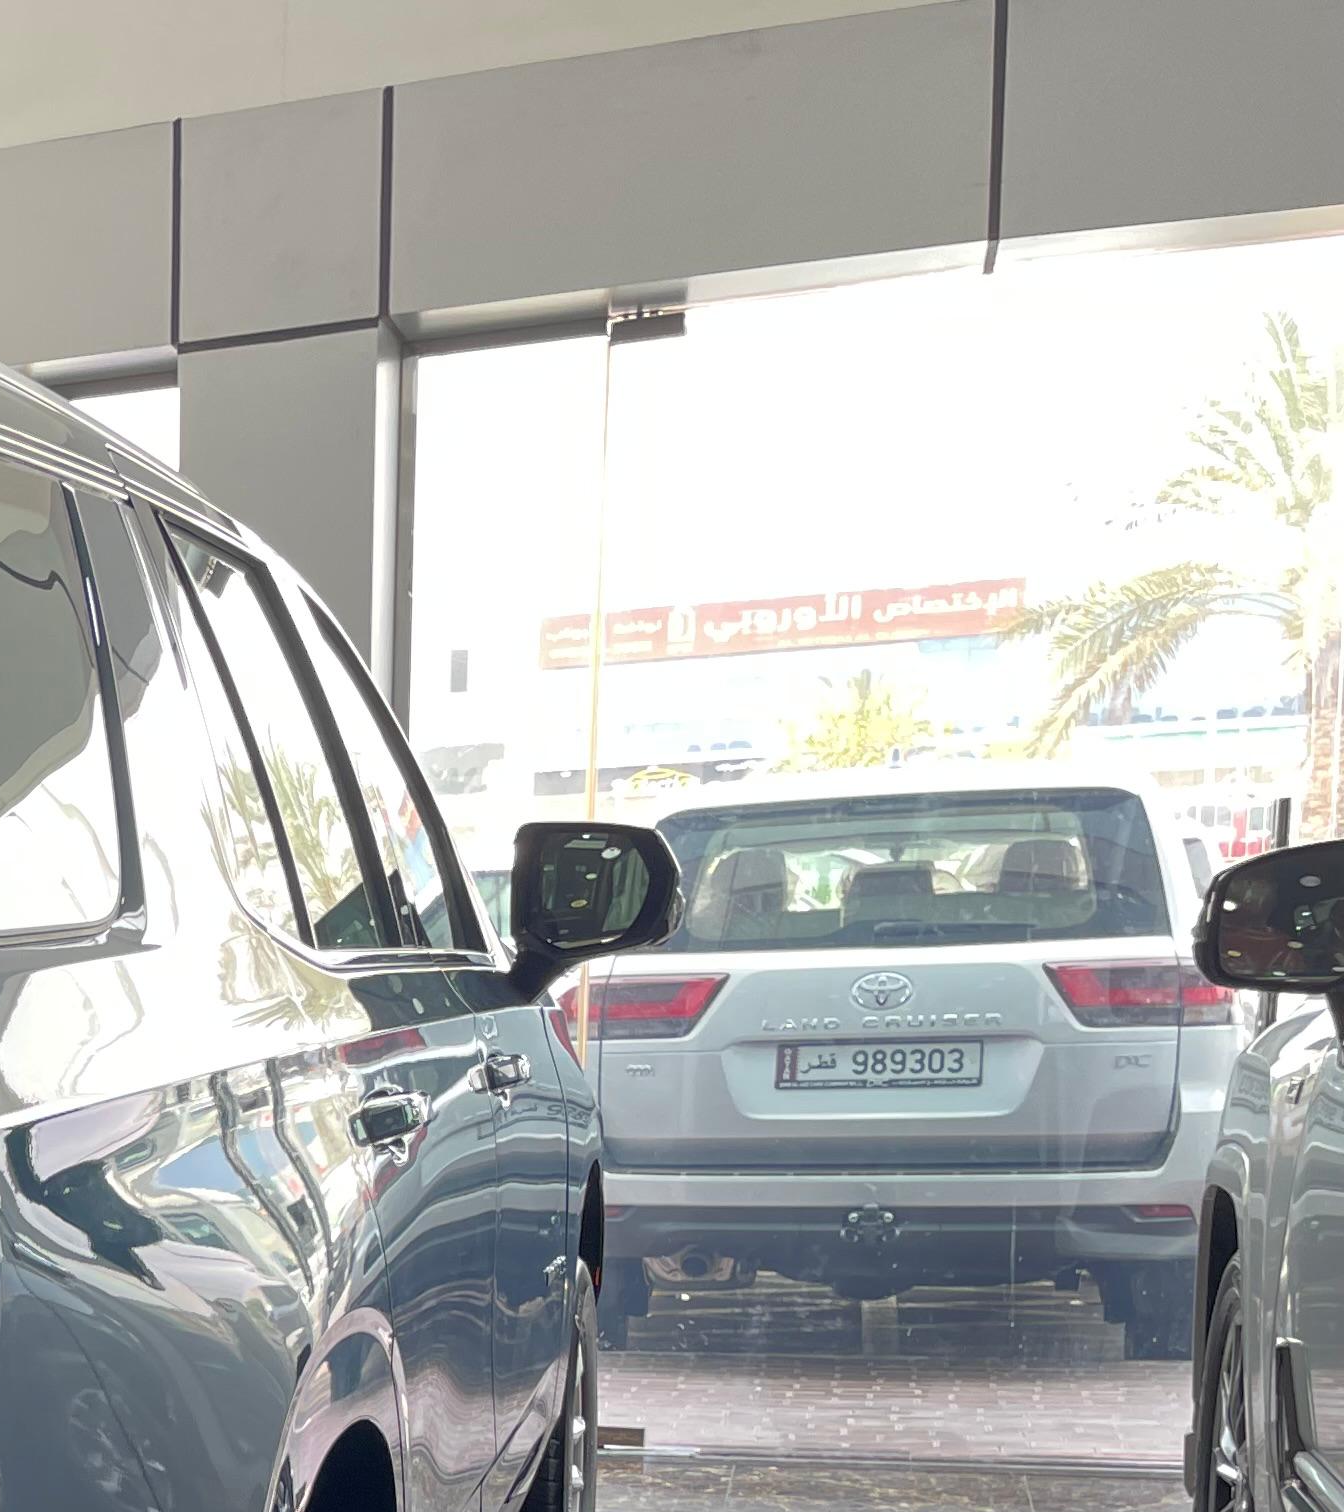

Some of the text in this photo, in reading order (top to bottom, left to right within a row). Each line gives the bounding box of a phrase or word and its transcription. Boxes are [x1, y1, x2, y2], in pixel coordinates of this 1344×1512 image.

[762, 1012, 1002, 1032] LAND CRUISER
[800, 1048, 965, 1075] قطر 989303
